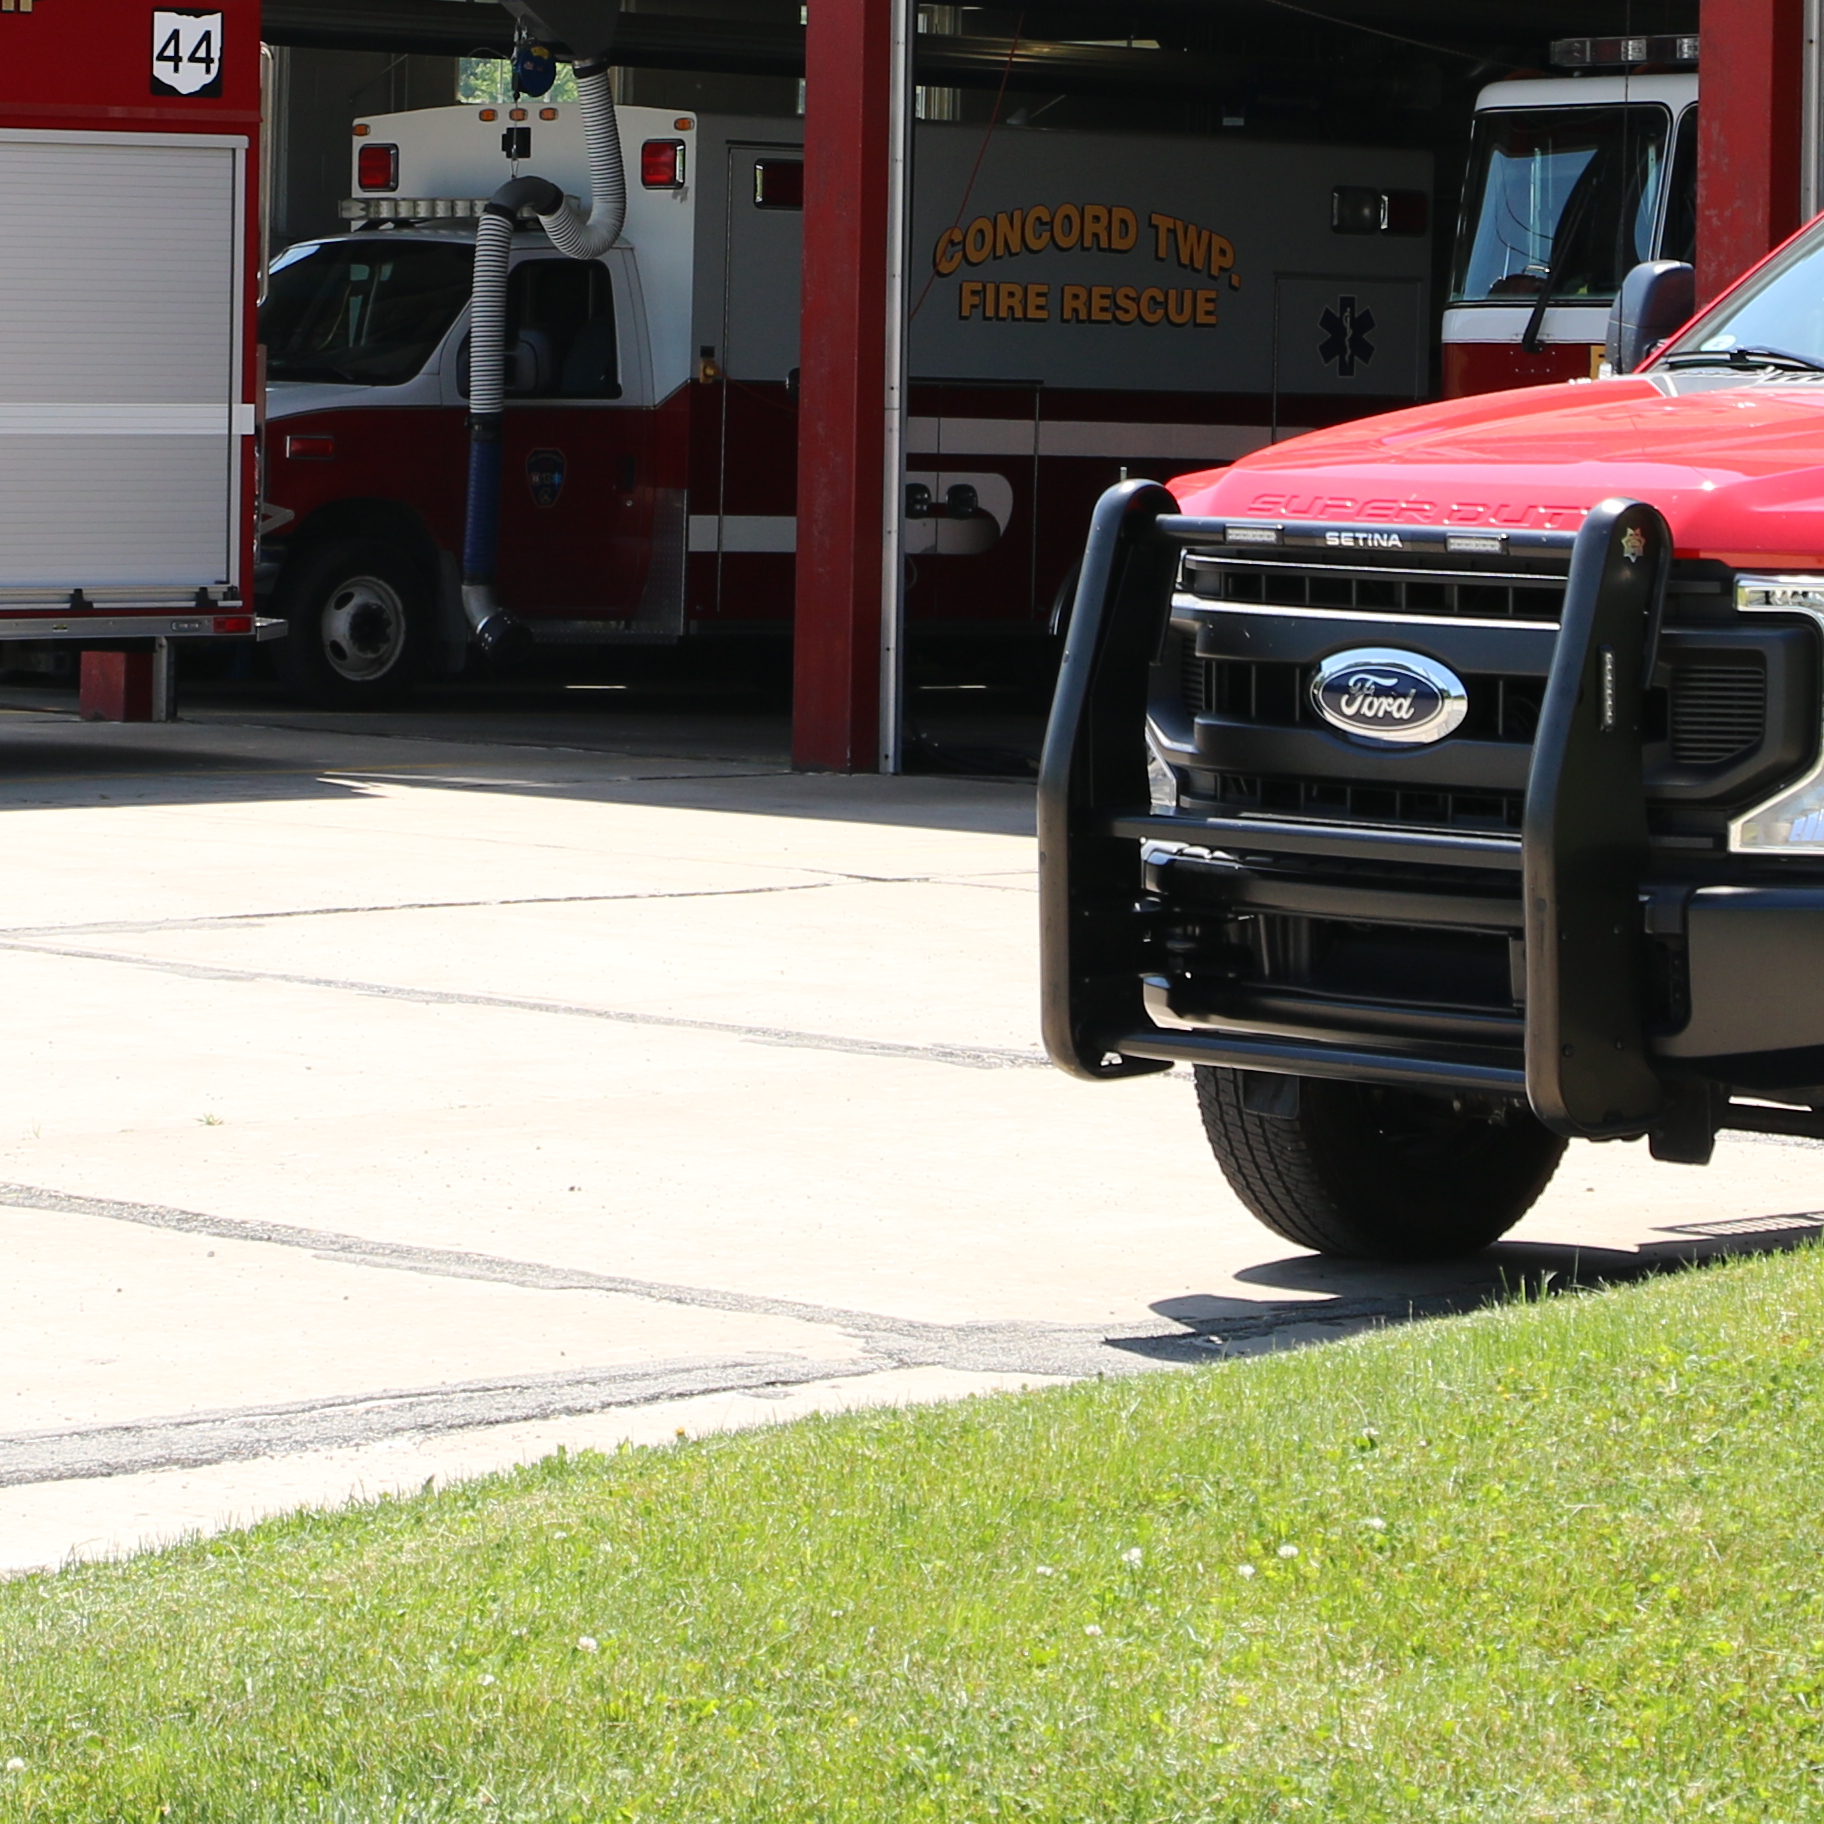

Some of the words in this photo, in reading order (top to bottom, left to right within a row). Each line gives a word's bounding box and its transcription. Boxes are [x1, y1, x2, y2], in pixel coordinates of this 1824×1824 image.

[154, 27, 216, 75] 44
[933, 202, 1139, 276] CONCORD
[1147, 212, 1243, 289] TWP.
[960, 281, 1051, 321] FIRE
[1062, 283, 1219, 326] RESCUE
[1247, 492, 1438, 524] SUPER
[1324, 530, 1404, 549] SETINA
[1339, 672, 1417, 721] Ford
